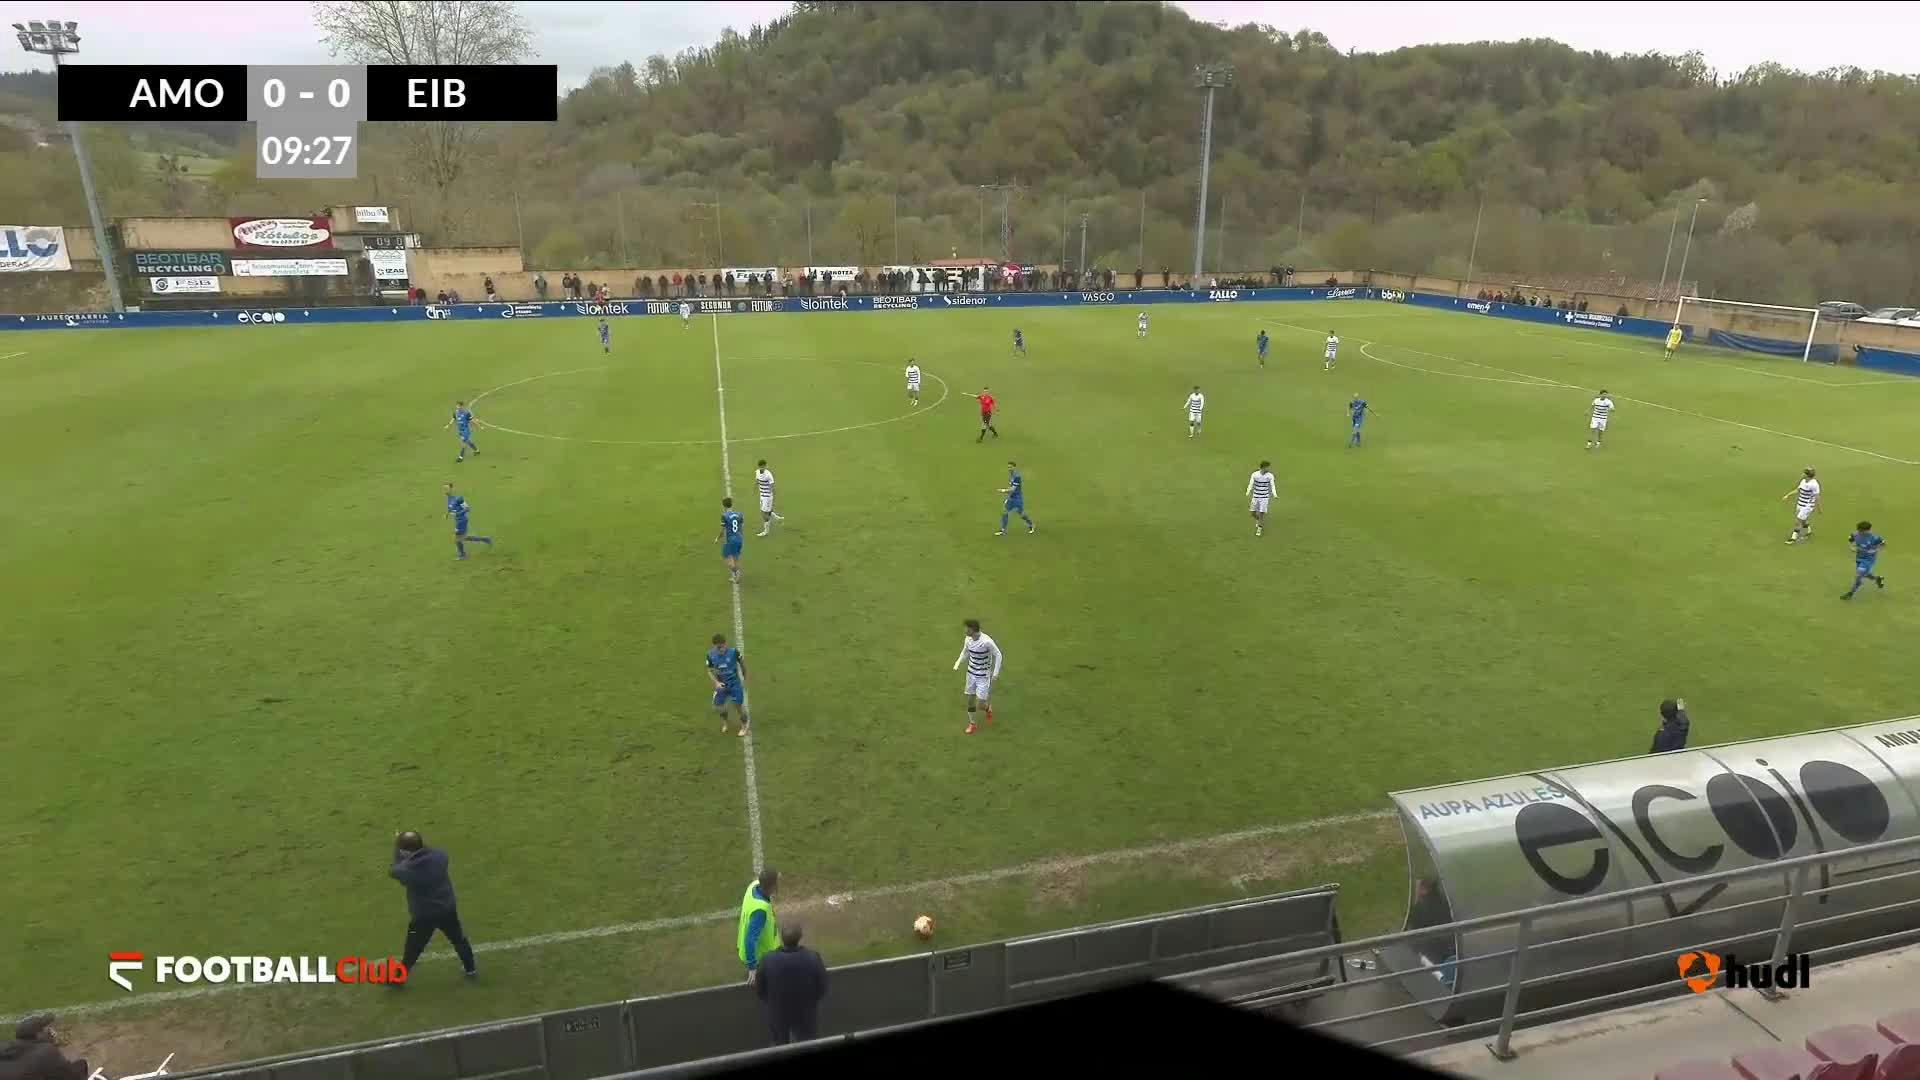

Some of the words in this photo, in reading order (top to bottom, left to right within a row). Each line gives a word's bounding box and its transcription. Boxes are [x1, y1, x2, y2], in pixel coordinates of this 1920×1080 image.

[136, 253, 222, 264] BEOTIBAR
[138, 265, 212, 273] RECYCLING
[1082, 292, 1115, 301] VASCO
[1209, 290, 1237, 299] ZALLO
[808, 298, 848, 310] lointek
[873, 296, 917, 304] BEOTIBAR
[952, 296, 987, 305] sidenor
[731, 518, 739, 533] 8
[1418, 799, 1481, 820] AUPA
[1481, 785, 1566, 810] AZULES
